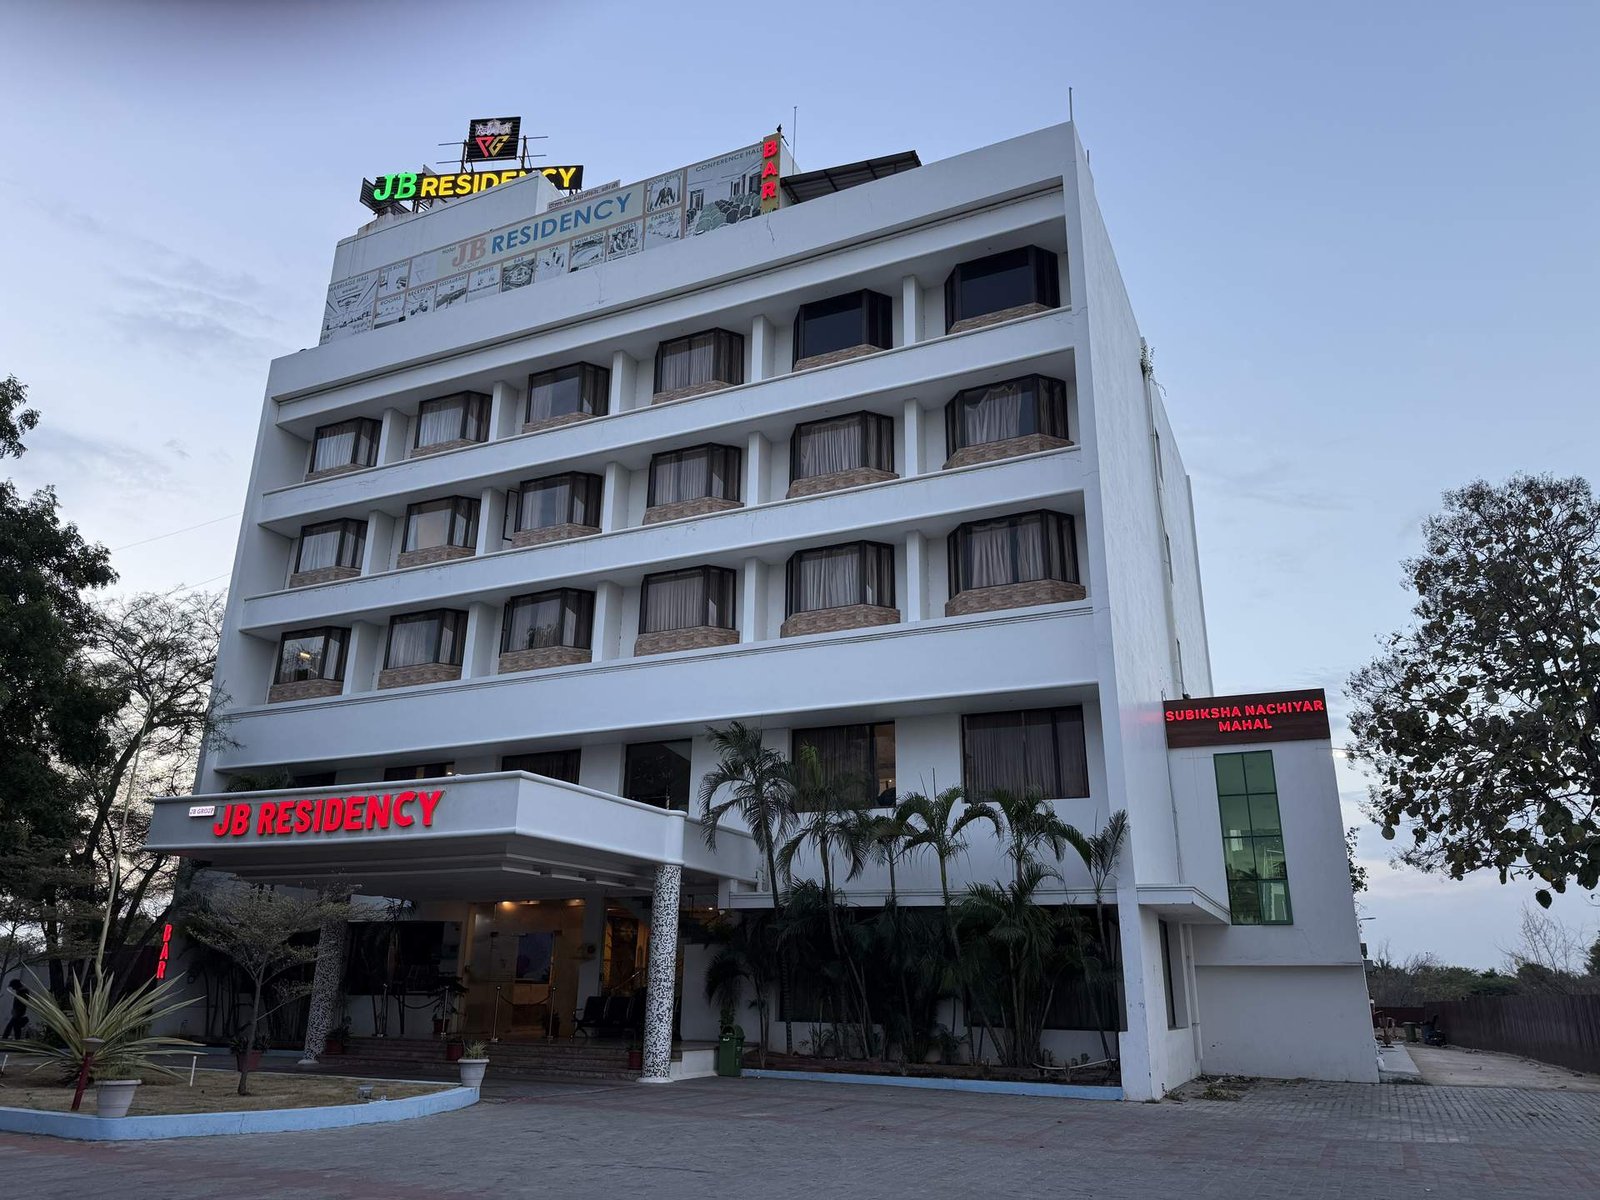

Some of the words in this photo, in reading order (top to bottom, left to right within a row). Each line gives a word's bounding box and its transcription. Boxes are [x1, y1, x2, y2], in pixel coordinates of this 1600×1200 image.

[696, 152, 743, 172] CONFERENCE
[762, 140, 778, 200] BAR
[374, 173, 418, 201] JB
[420, 167, 576, 197] RESIDEY
[452, 238, 487, 267] JB
[491, 192, 631, 254] RESIDENCY
[407, 285, 435, 297] RECEPTION
[1165, 706, 1241, 722] SUBIKSHA
[1245, 700, 1324, 716] NACHIYAR
[1218, 718, 1273, 733] MAHAL
[213, 803, 251, 837] JB
[257, 790, 444, 836] RESIDENCY
